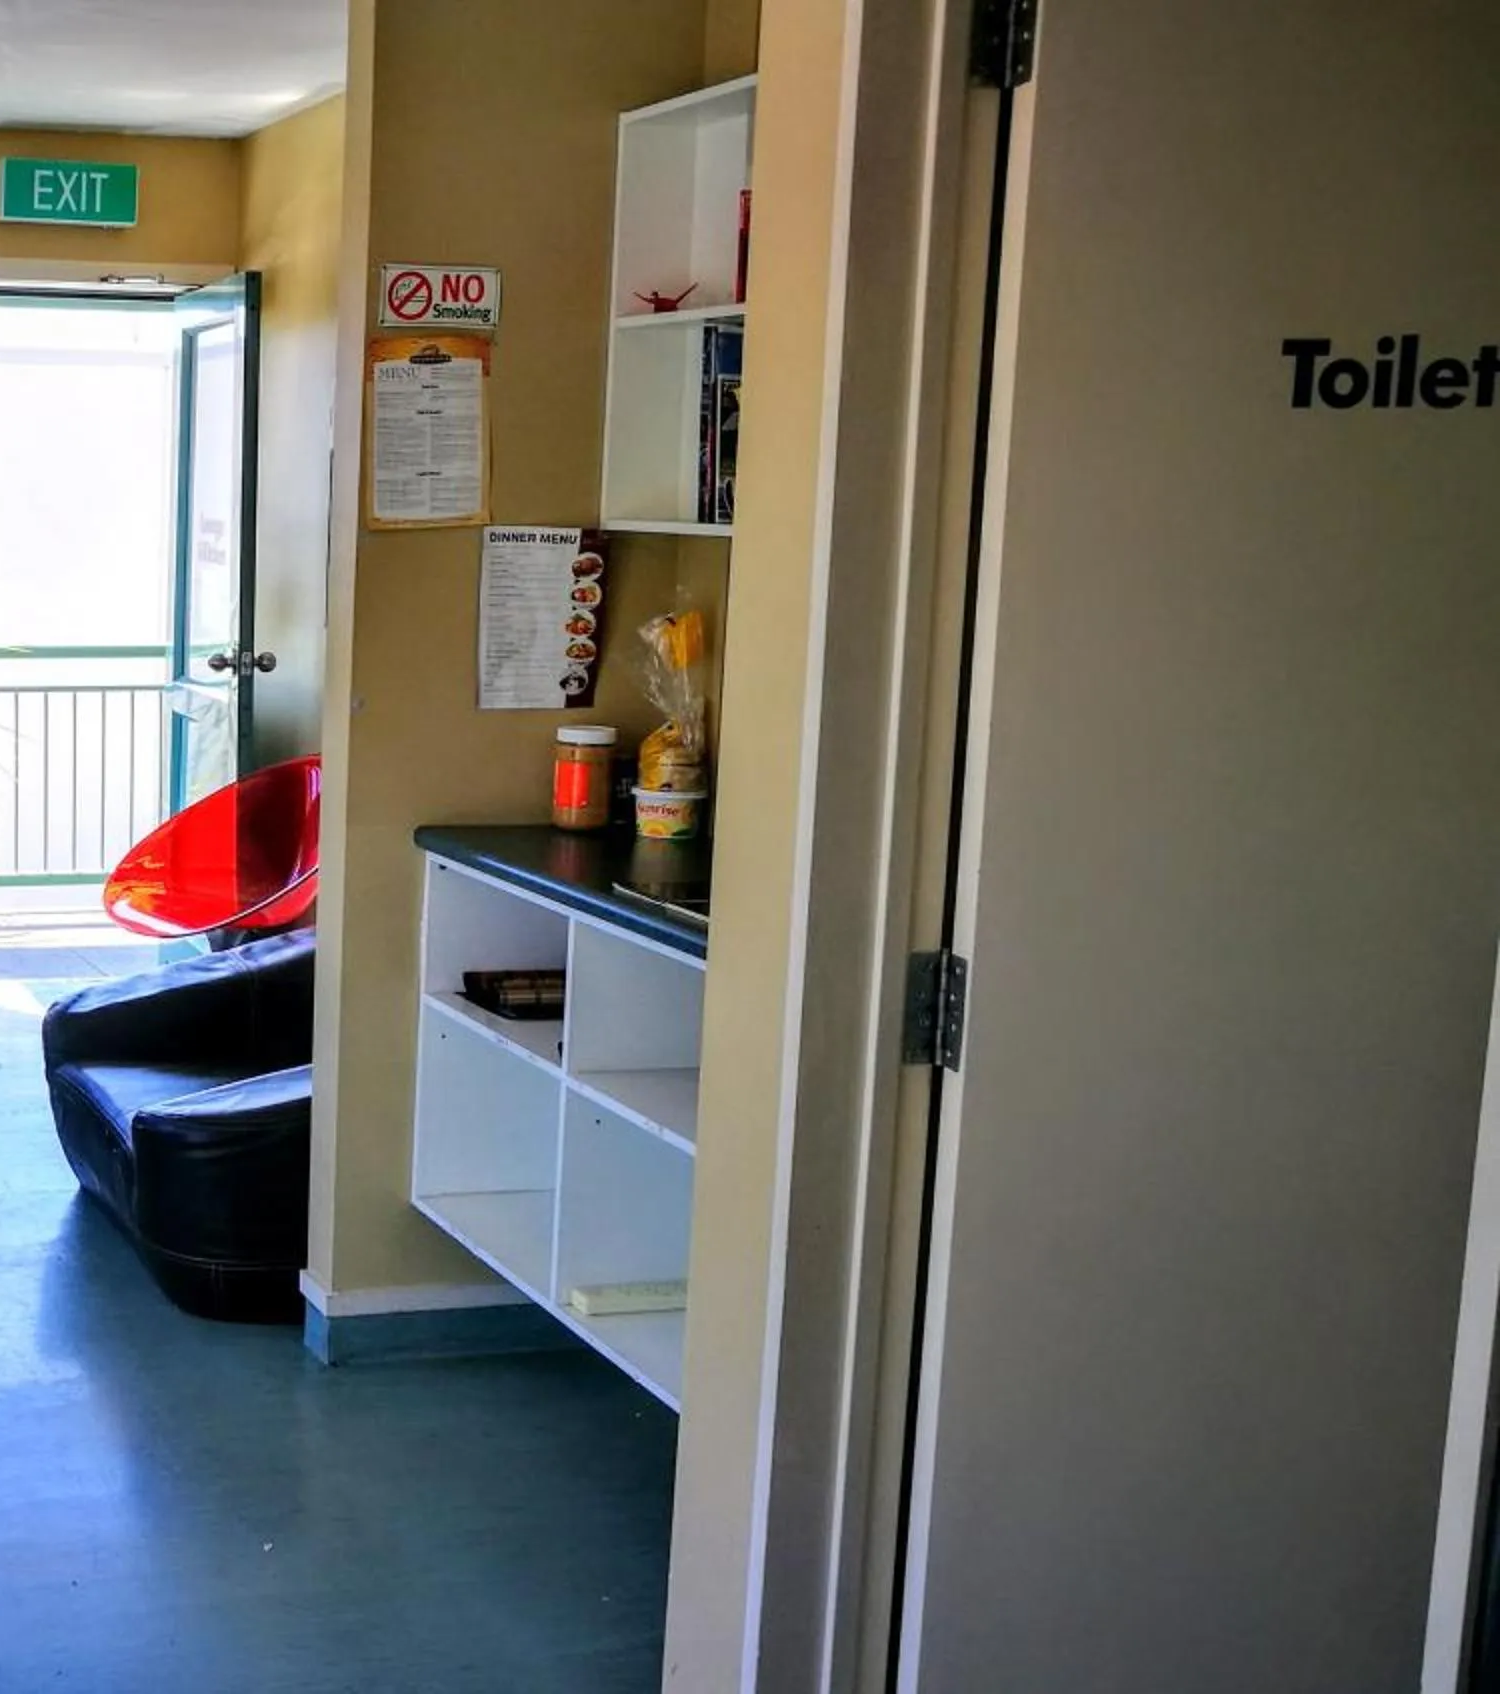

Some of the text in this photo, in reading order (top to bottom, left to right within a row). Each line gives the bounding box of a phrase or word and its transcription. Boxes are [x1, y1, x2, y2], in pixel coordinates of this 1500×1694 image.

[33, 168, 110, 213] EXIT
[441, 273, 485, 303] NO
[433, 303, 492, 322] Smoking
[378, 366, 421, 380] MENU
[1281, 334, 1500, 410] Toilet
[490, 532, 578, 544] DINNER MENU
